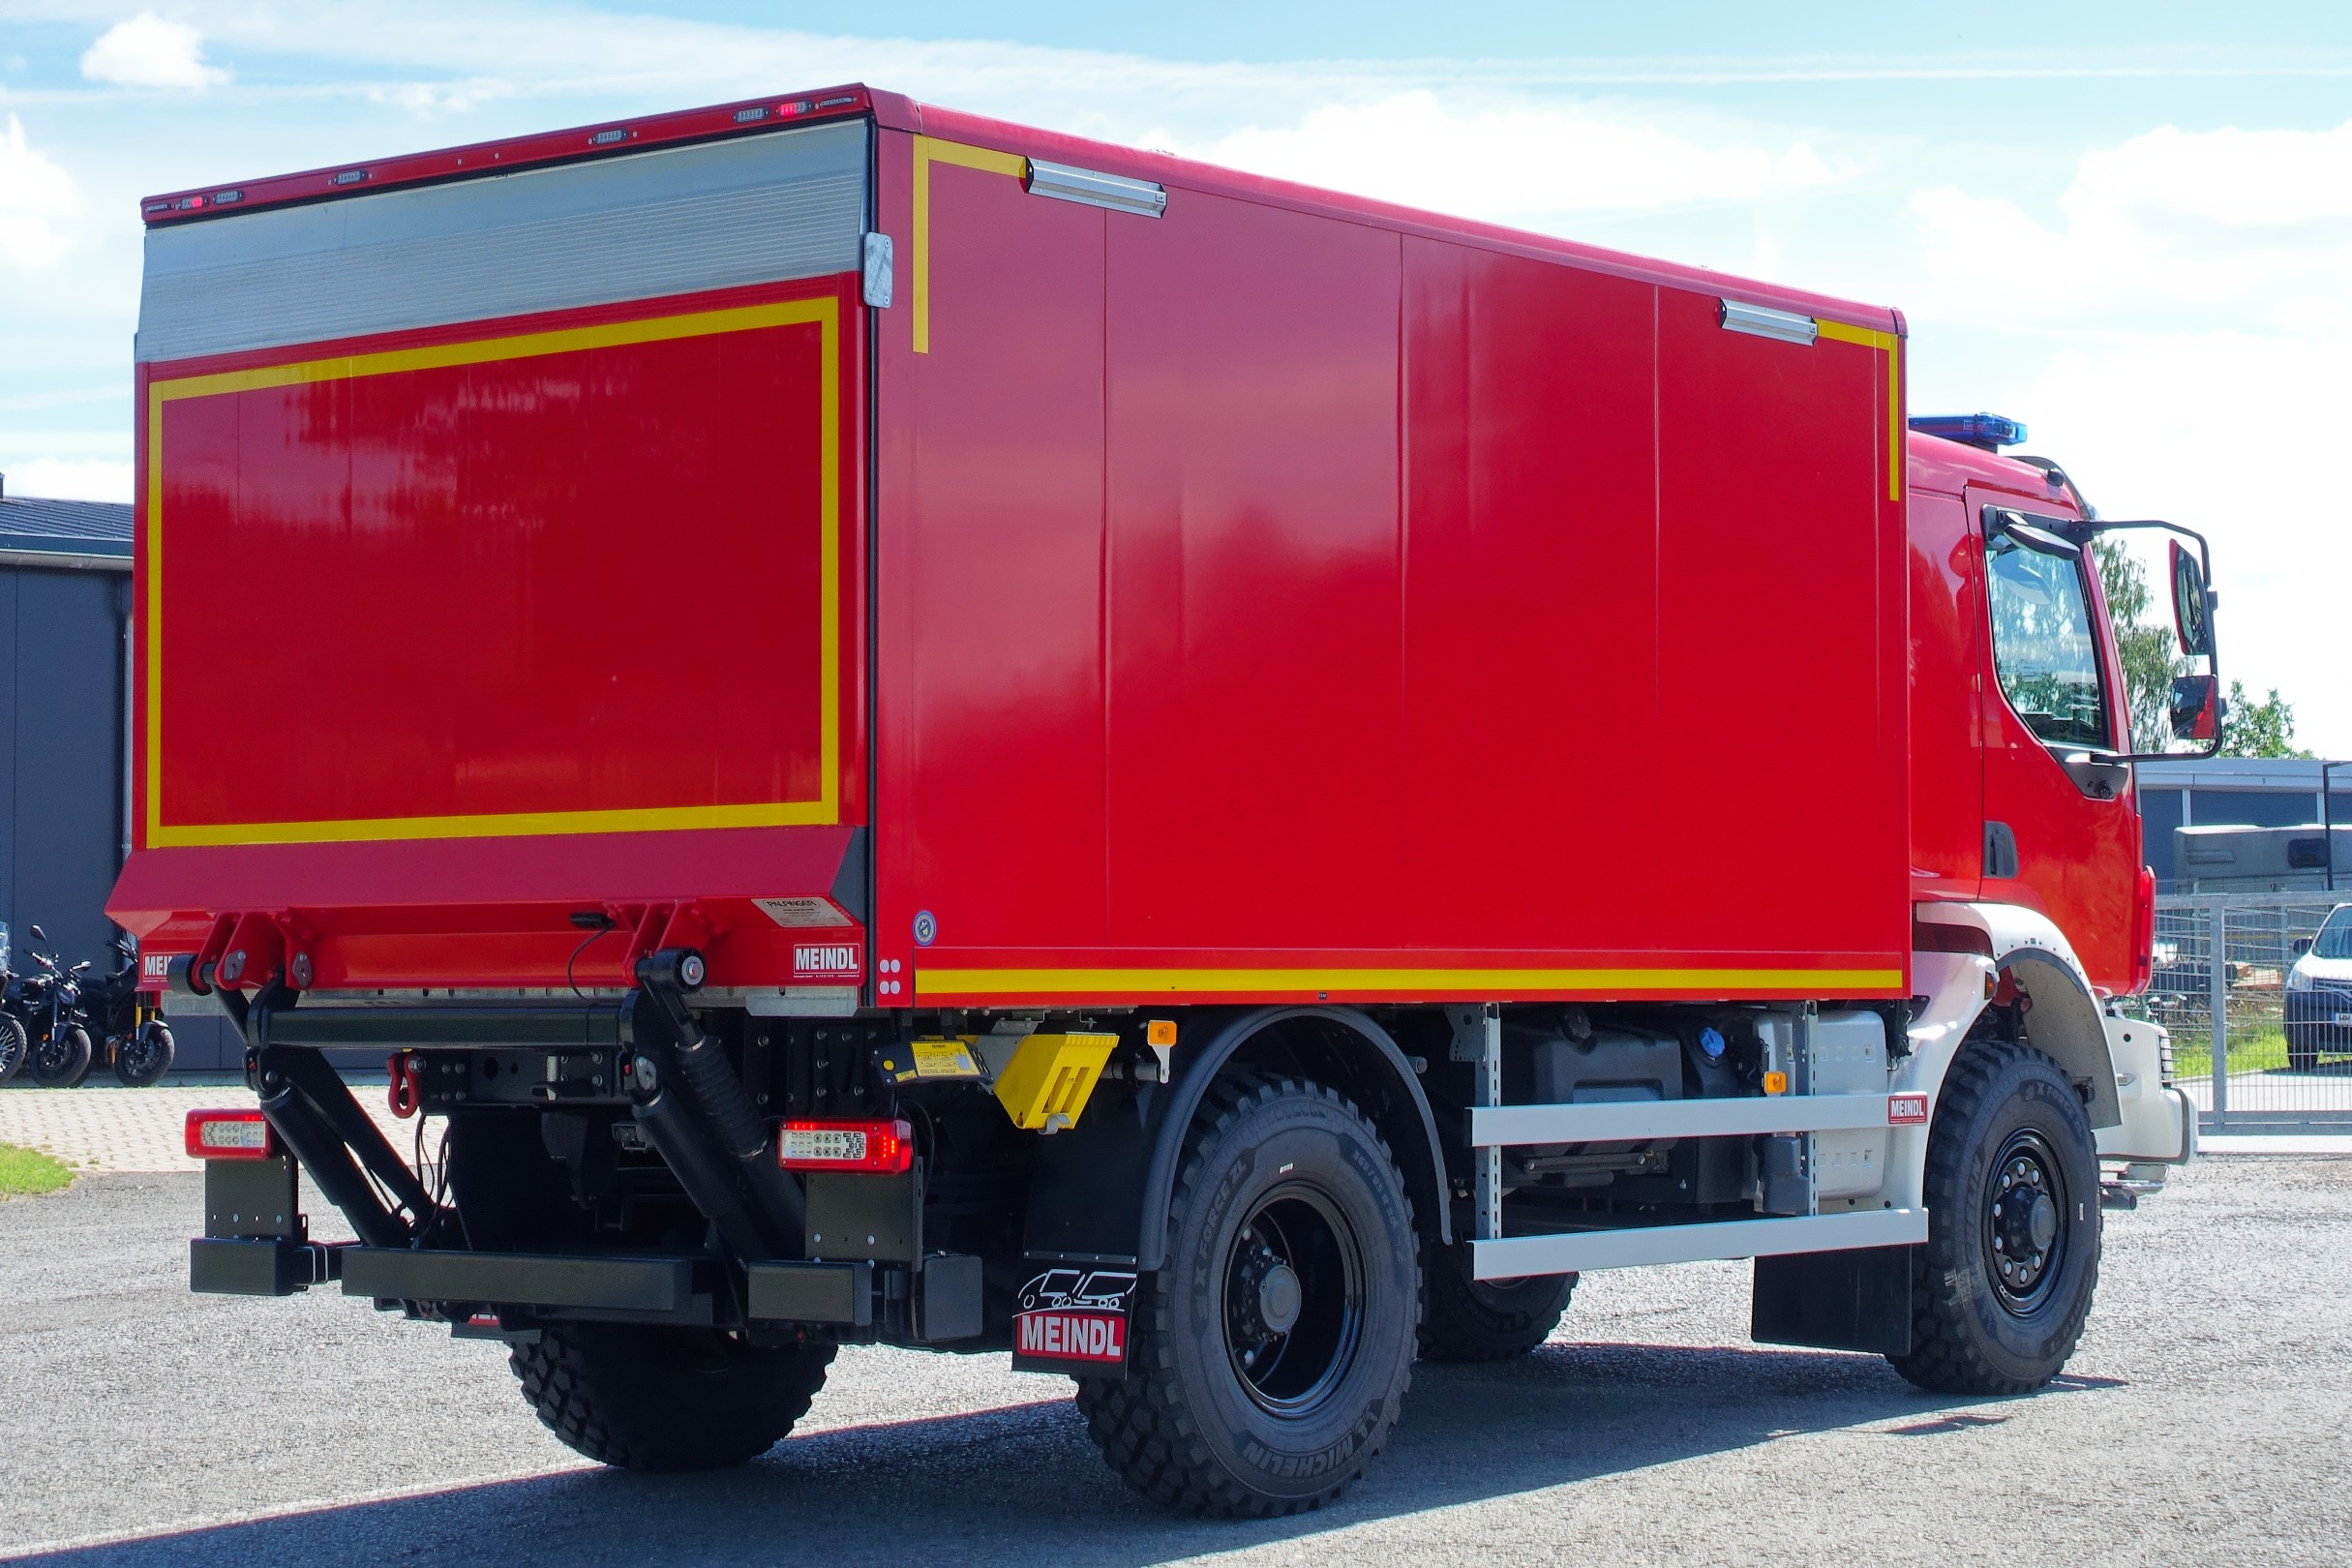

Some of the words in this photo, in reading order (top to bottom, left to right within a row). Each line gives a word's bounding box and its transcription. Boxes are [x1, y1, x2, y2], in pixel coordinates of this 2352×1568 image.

[796, 948, 858, 971] MEINDL
[1891, 1099, 1924, 1117] MEINDL
[1198, 1179, 1231, 1260] FORCE
[1229, 1158, 1248, 1187] ZL
[1021, 1314, 1121, 1356] MEINDL
[1241, 1432, 1354, 1479] MICHELIN
